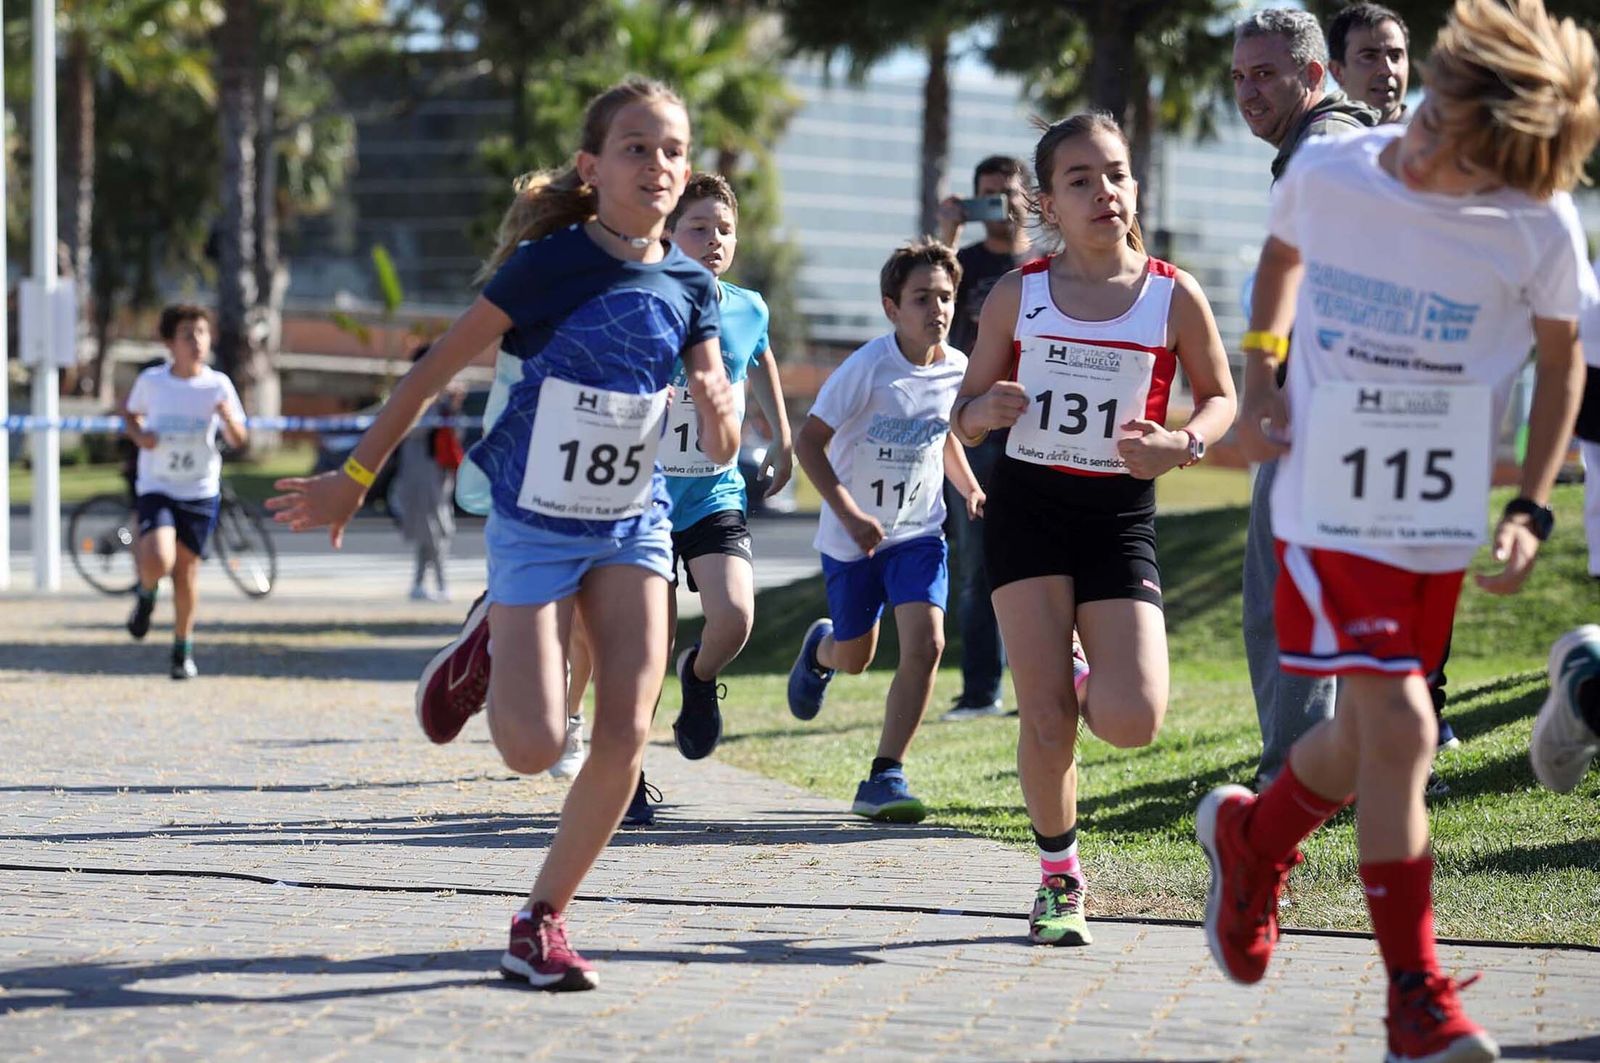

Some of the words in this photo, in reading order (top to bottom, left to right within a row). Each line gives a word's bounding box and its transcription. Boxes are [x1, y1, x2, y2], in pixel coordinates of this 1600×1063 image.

[1048, 344, 1067, 361] H
[1084, 356, 1120, 367] HUELVA
[1035, 389, 1119, 439] 131
[169, 452, 195, 471] 26
[559, 439, 646, 486] 185
[1017, 444, 1044, 459] Huelva
[1073, 454, 1088, 465] tus
[1341, 446, 1456, 502] 115
